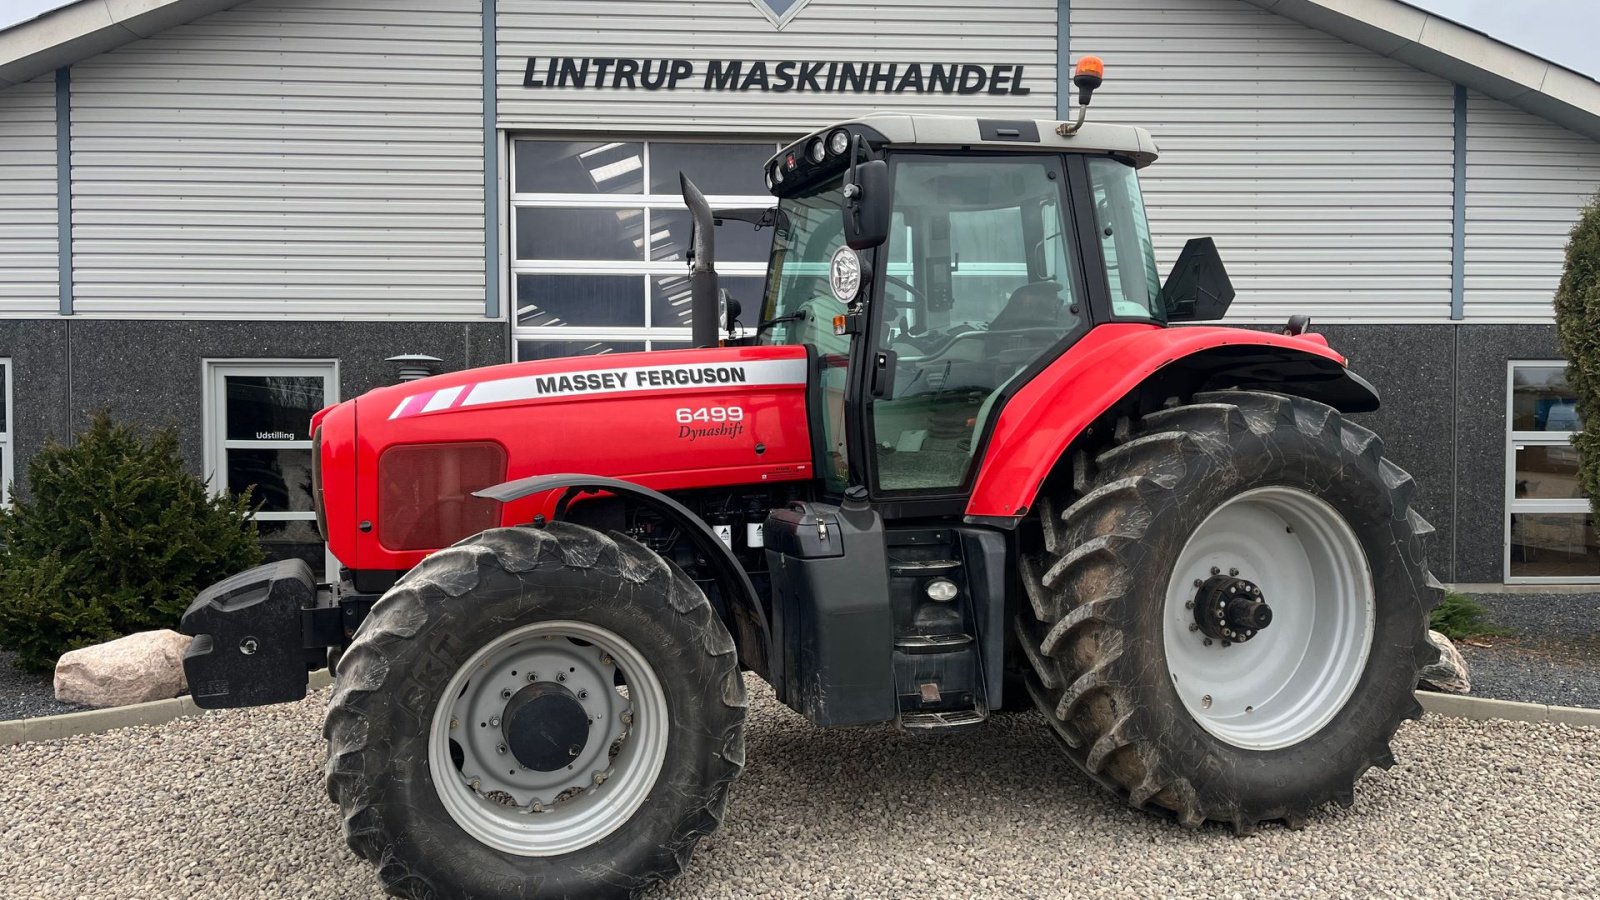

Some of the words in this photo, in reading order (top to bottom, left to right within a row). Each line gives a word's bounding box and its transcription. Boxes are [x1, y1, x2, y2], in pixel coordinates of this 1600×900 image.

[522, 56, 694, 90] LINTRUP
[703, 60, 1031, 96] MASKINHANDEL
[535, 371, 628, 394] MASSEY
[636, 366, 746, 387] FERGUSON
[676, 406, 743, 423] 6499
[256, 431, 295, 441] Udstilling
[678, 421, 744, 442] Dynashift
